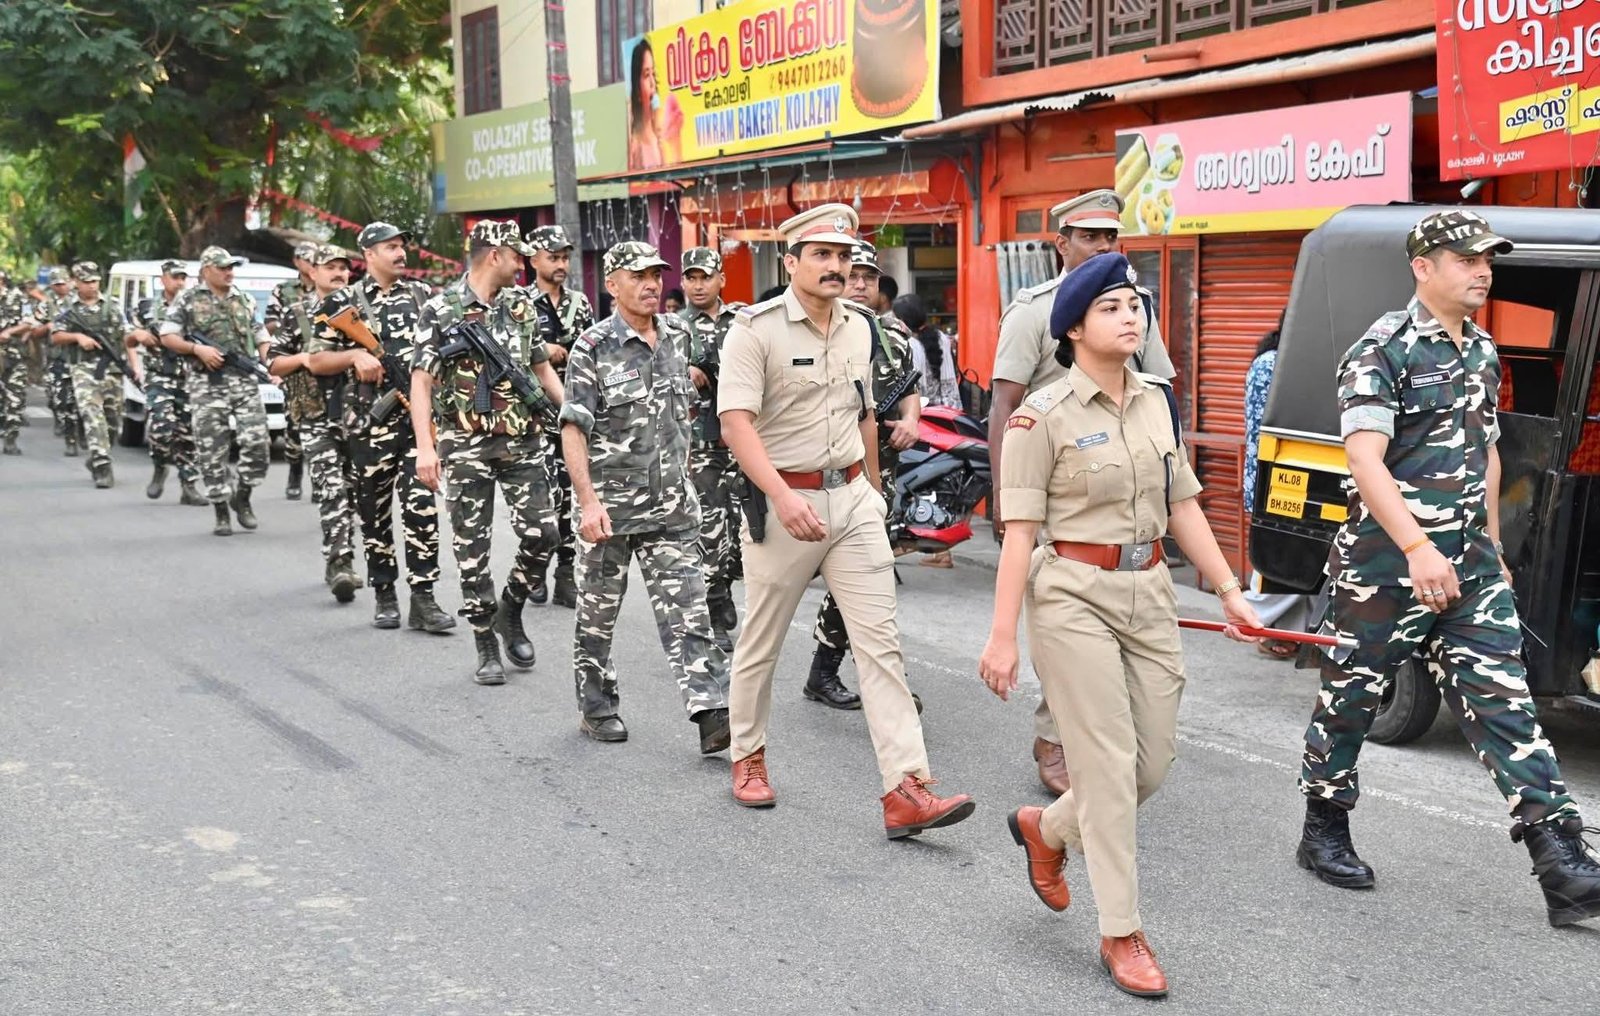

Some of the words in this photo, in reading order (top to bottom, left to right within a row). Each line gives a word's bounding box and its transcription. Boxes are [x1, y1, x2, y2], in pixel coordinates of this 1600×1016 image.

[778, 58, 846, 90] 9447012260
[704, 76, 751, 109] കോലഴി
[695, 109, 735, 147] VIKRAM
[738, 98, 782, 140] BAKERY,
[785, 84, 841, 131] KOLAZHY
[472, 122, 529, 153] KOLAZHY
[465, 147, 553, 181] CO-OPERATIVE
[1194, 134, 1295, 193] അശ്വതി
[1493, 150, 1525, 164] KOLAZHY
[1279, 472, 1302, 485] KL.08
[1270, 499, 1301, 513] BH.8256
